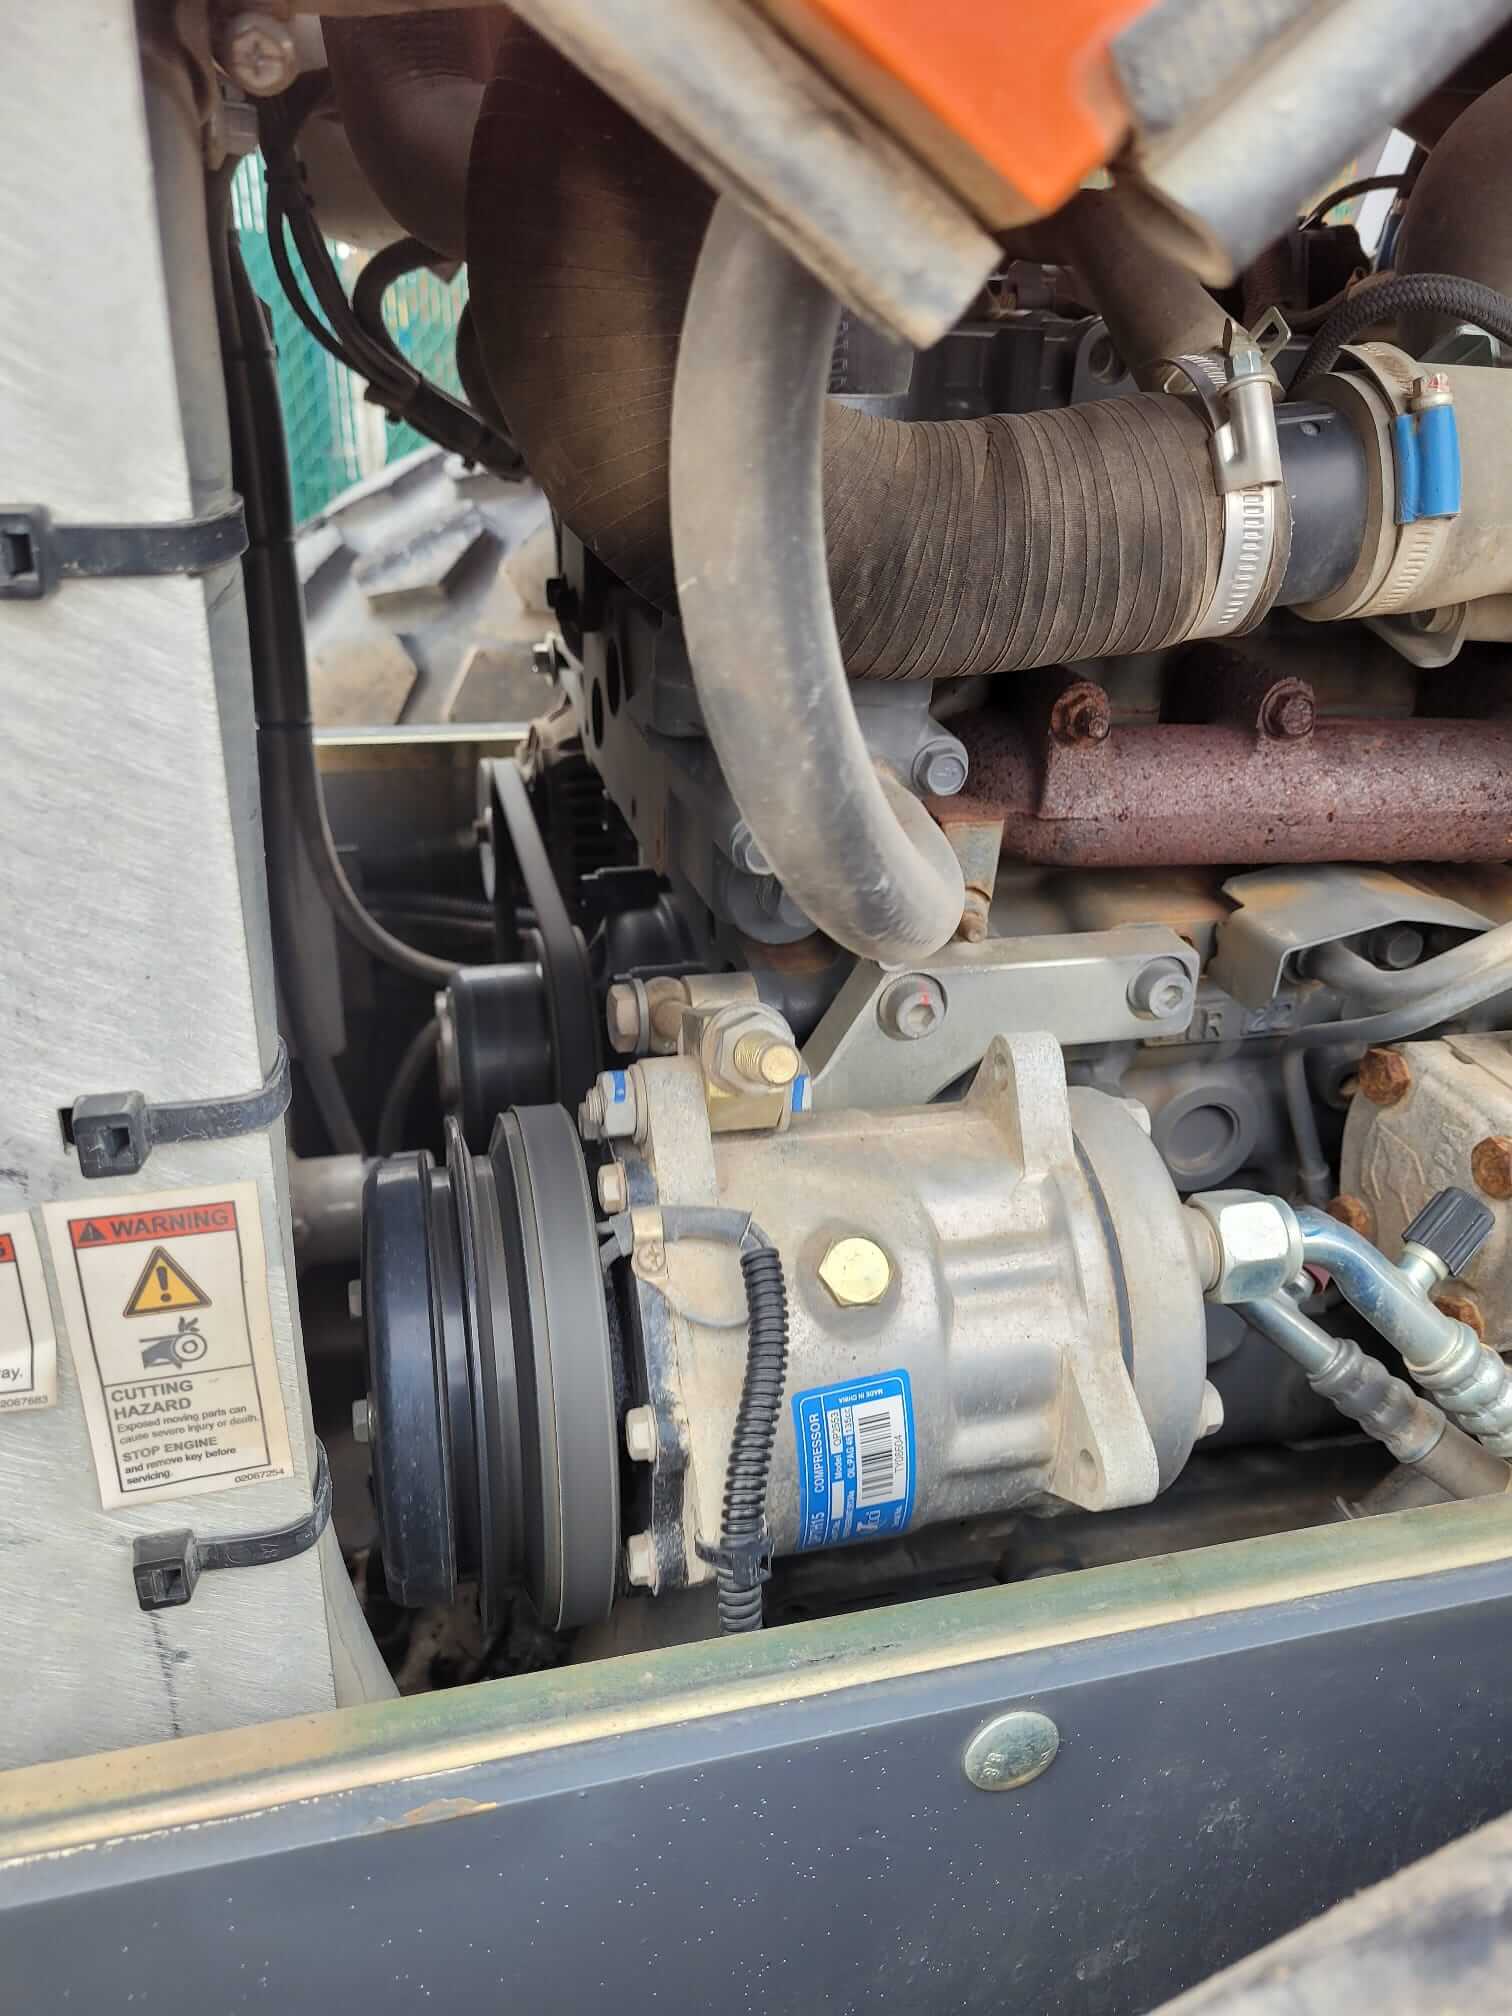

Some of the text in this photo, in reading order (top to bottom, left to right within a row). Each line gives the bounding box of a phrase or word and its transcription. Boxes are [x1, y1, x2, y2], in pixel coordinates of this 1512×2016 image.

[111, 1209, 228, 1237] WARNING
[0, 1367, 23, 1382] ay.
[111, 1380, 193, 1402] CUTTING
[114, 1397, 191, 1420] HAZARD
[117, 1405, 247, 1434] Exposed moving parts can
[842, 1407, 852, 1432] 135cc
[119, 1433, 150, 1445] cause
[151, 1427, 185, 1439] severe
[187, 1421, 215, 1436] injury
[217, 1420, 228, 1430] or
[122, 1436, 218, 1463] STOP ENGINE
[124, 1446, 236, 1474] and remove key before
[808, 1413, 825, 1493] COMPRESSOR
[235, 1467, 285, 1484] 02067254
[833, 1454, 842, 1480] Model
